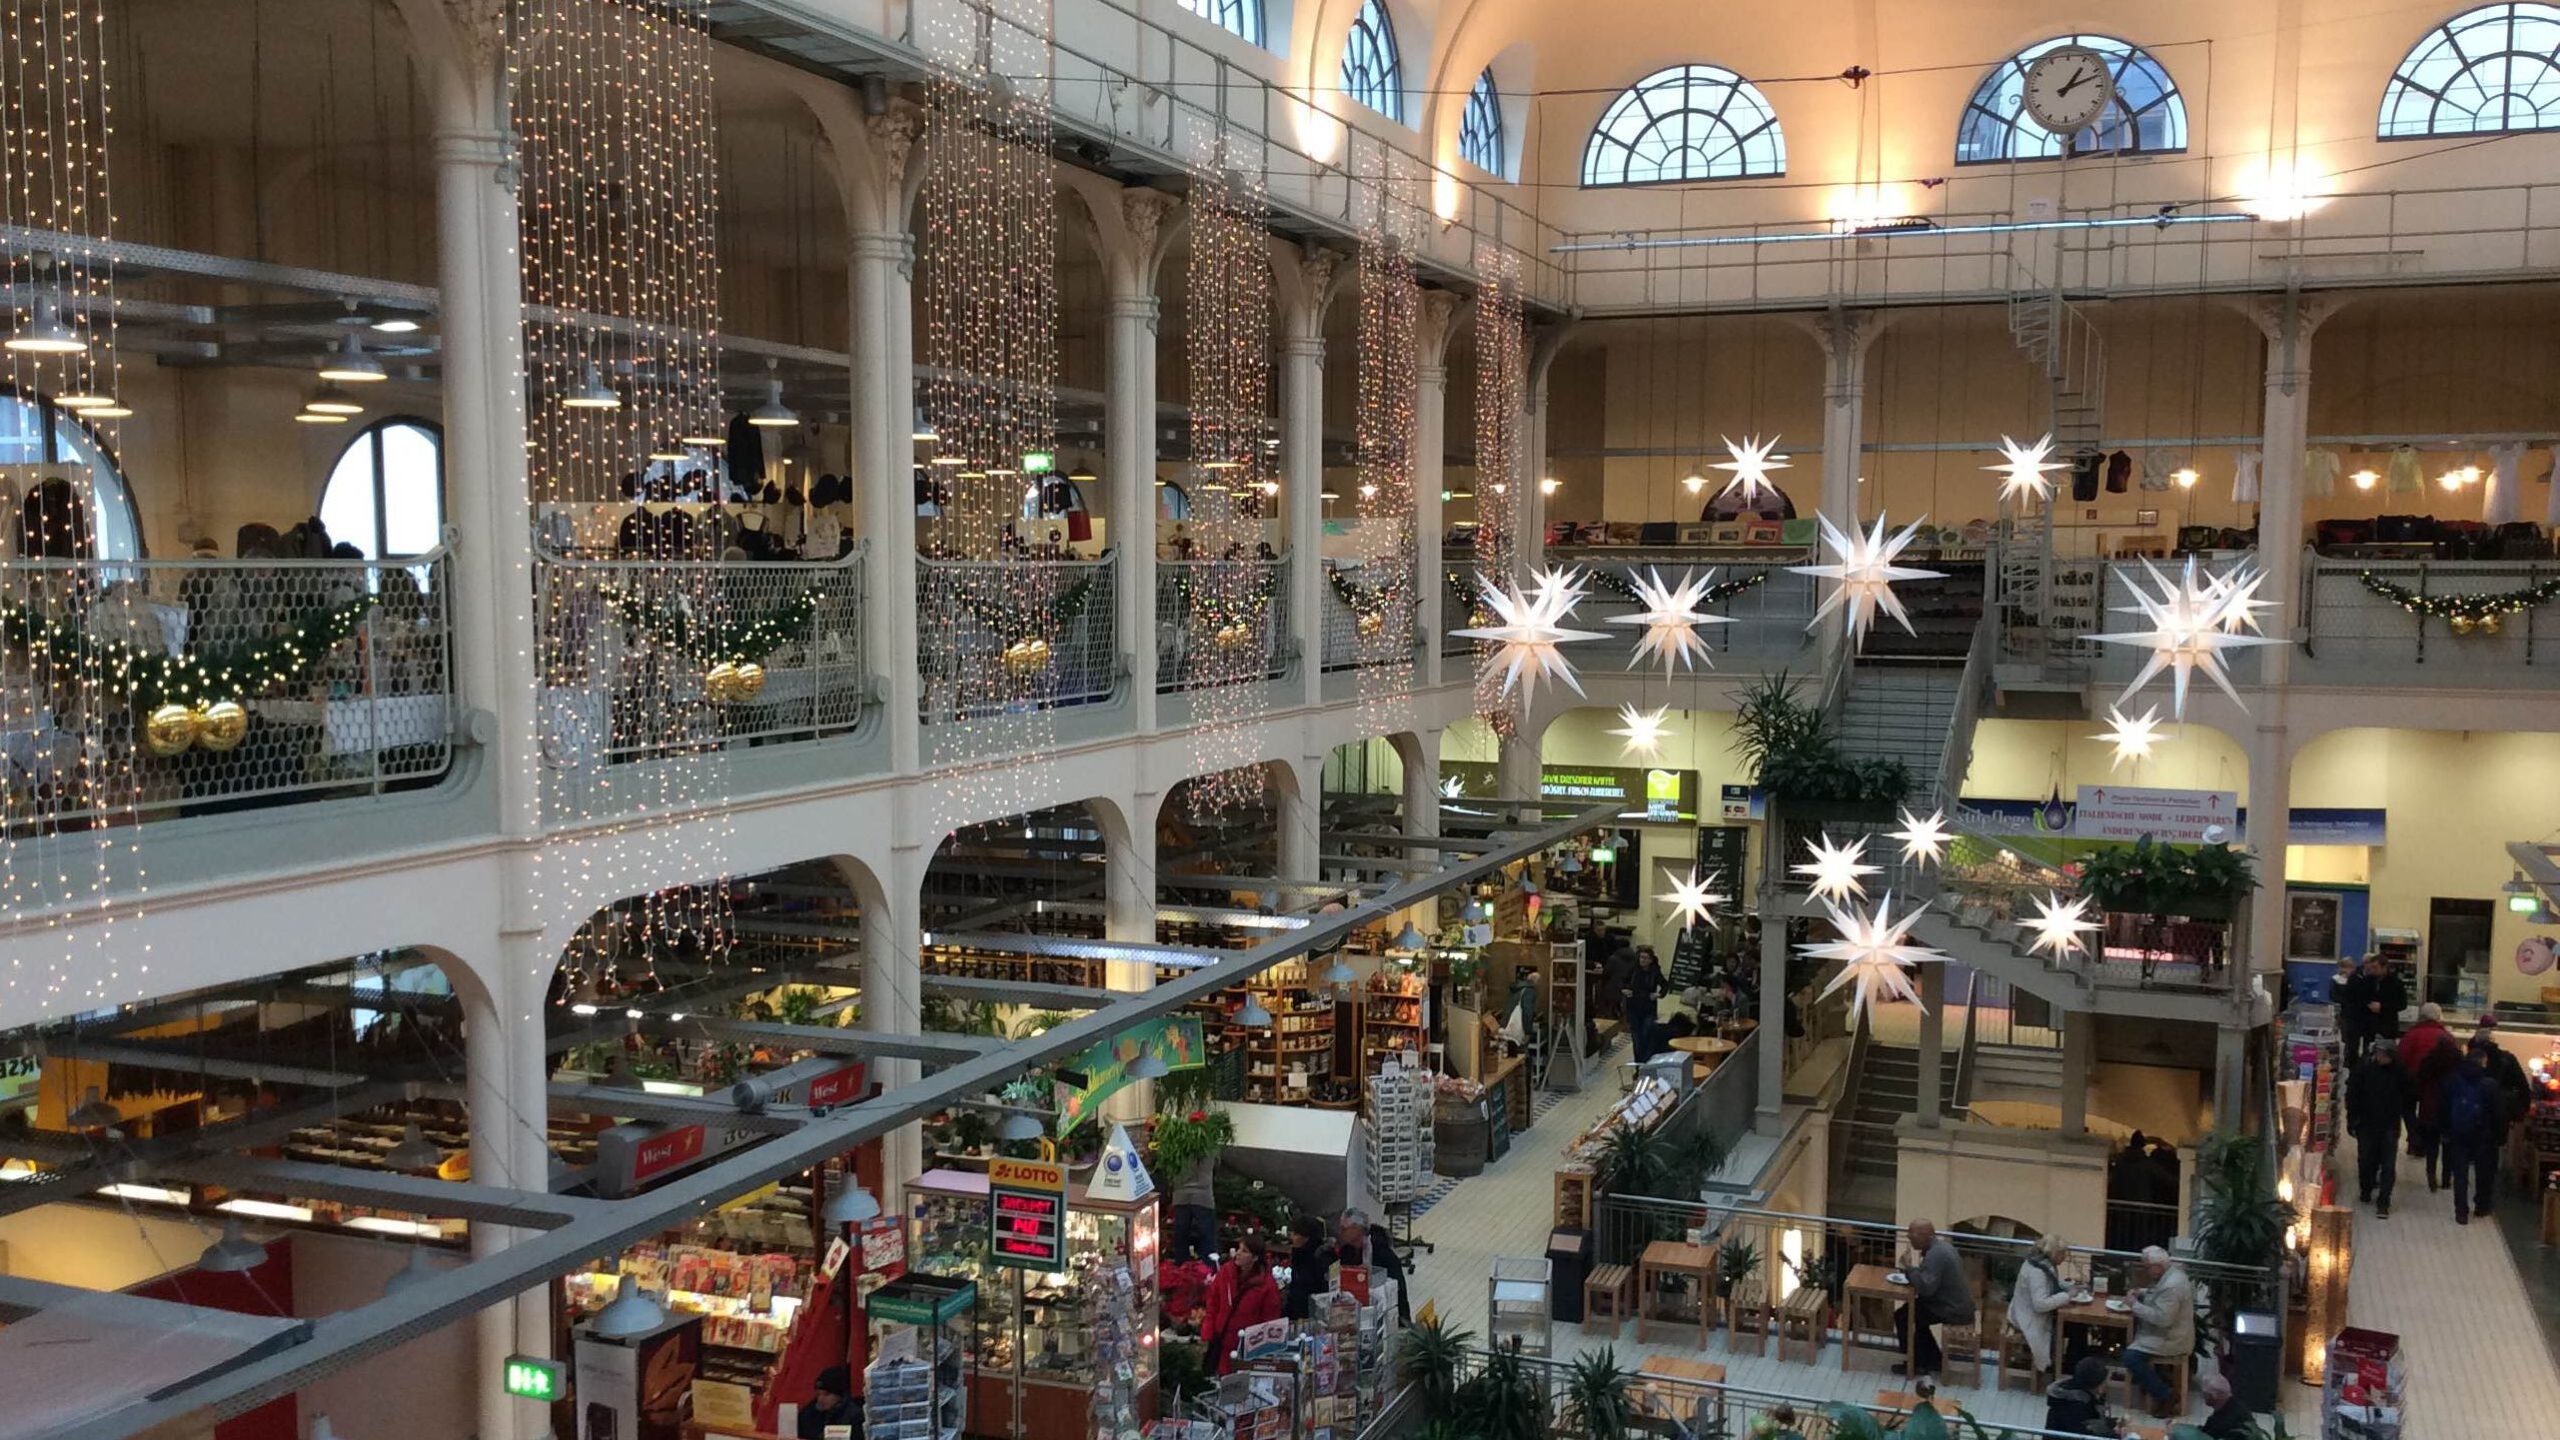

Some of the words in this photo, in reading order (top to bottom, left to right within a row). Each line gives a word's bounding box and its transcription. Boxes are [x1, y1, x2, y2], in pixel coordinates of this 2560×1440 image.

[814, 1080, 838, 1100] West
[642, 1143, 672, 1165] West
[1014, 1166, 1059, 1184] LOTTO
